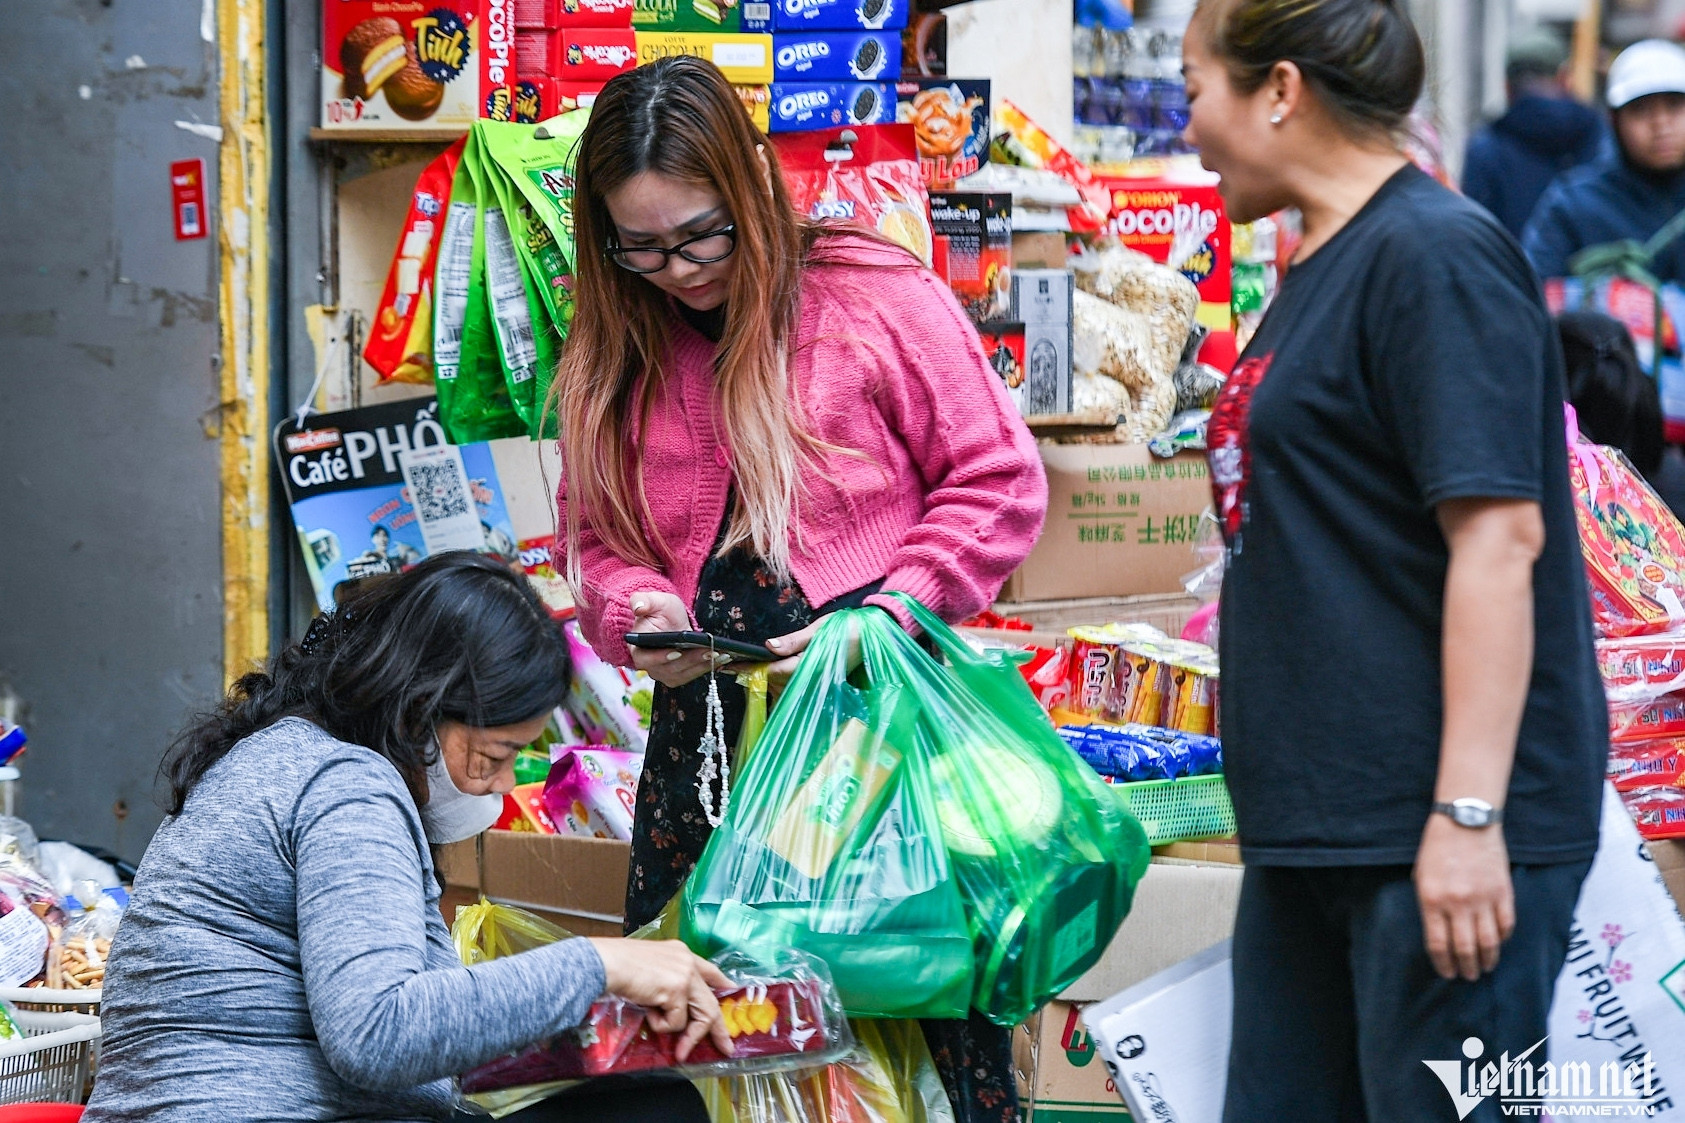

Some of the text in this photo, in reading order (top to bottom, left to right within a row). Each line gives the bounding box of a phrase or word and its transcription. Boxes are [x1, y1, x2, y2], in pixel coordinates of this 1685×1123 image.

[777, 42, 829, 67] OREO
[779, 91, 829, 117] OREO
[1130, 191, 1178, 208] ORION
[289, 447, 350, 488] Café
[1078, 523, 1126, 543] 芝麻味
[1576, 962, 1639, 1044] FRUIT
[1618, 1043, 1674, 1119] WINE
